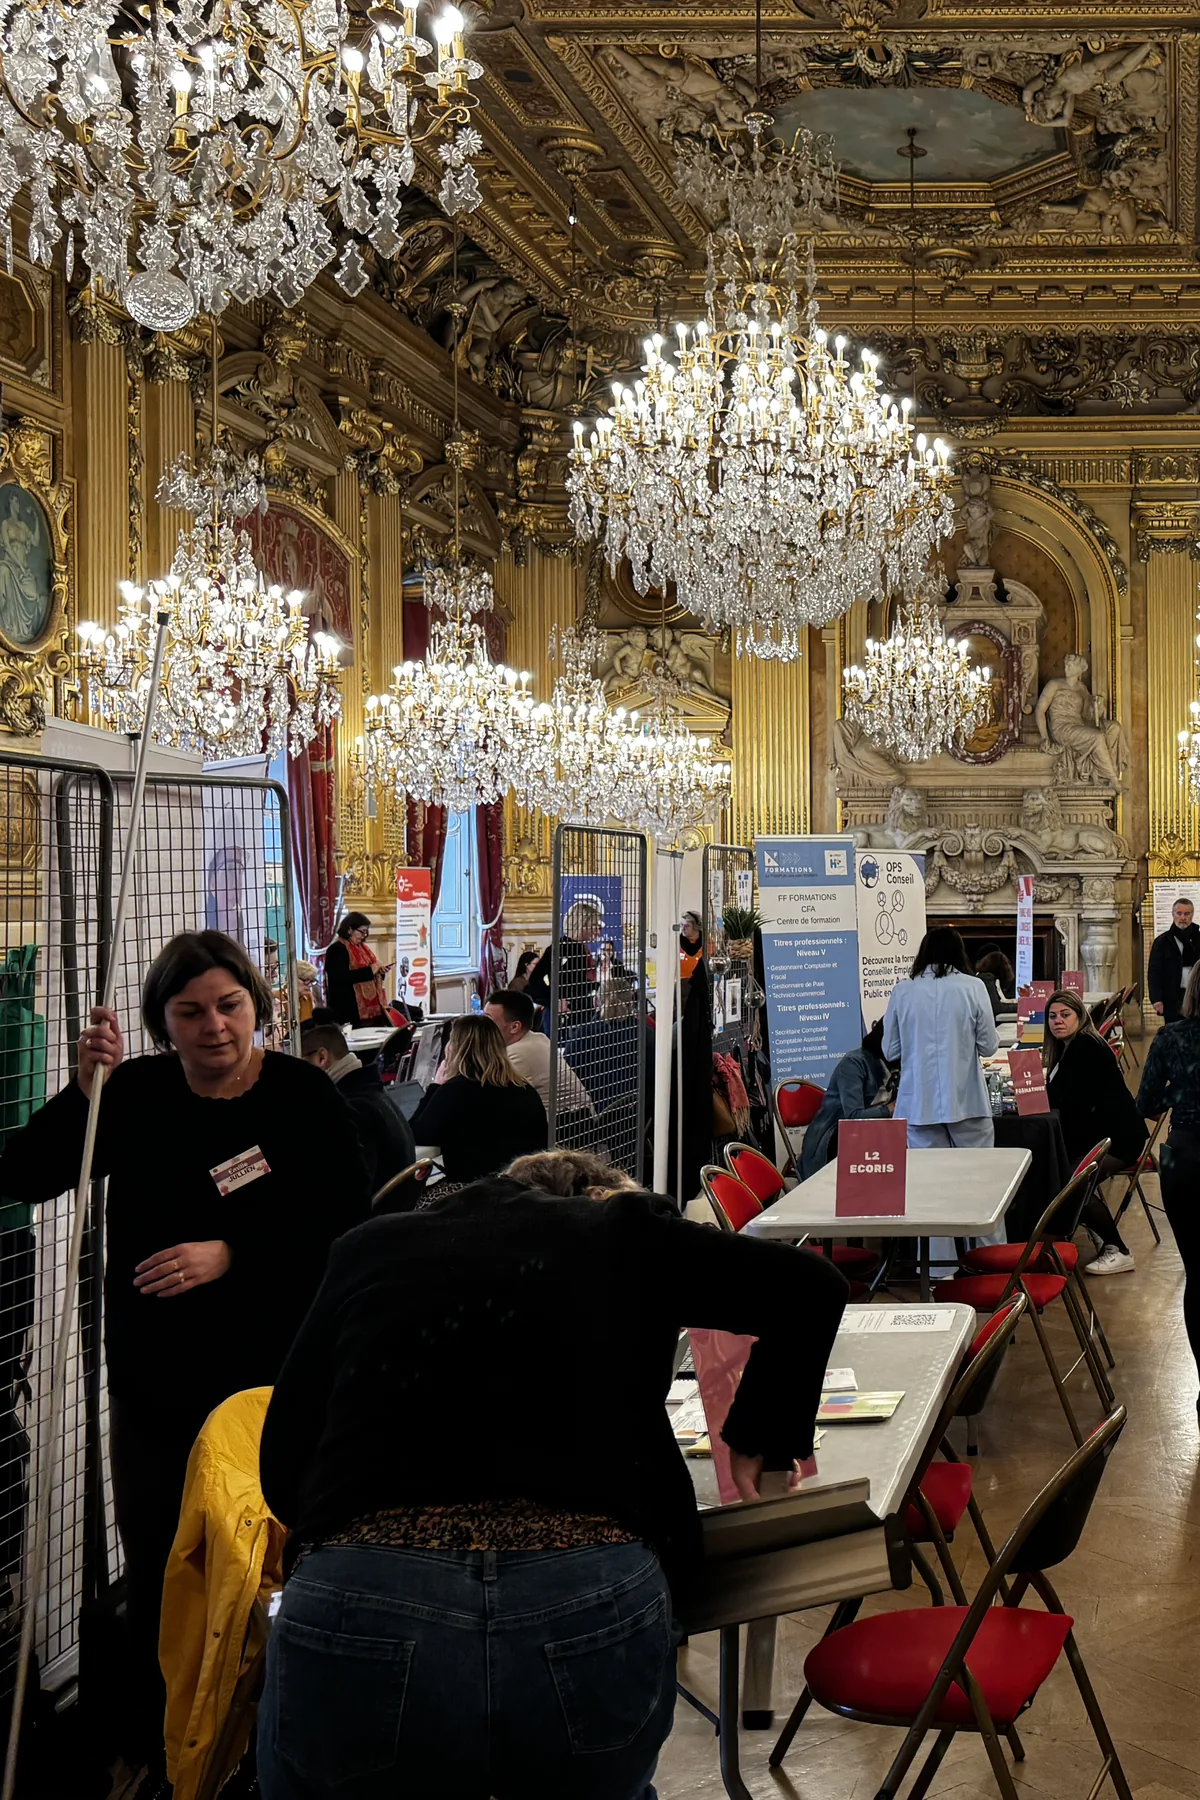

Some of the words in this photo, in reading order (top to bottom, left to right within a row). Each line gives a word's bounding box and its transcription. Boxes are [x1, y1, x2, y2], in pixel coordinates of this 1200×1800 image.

[886, 862, 902, 872] OPS
[886, 873, 914, 884] Conseil
[789, 893, 836, 901] FORMATIONS
[777, 917, 799, 925] Centre
[811, 916, 841, 924] formation
[794, 937, 843, 947] professionnels
[862, 956, 894, 965] Découvrez
[895, 955, 901, 963] la
[902, 955, 916, 963] form
[803, 962, 831, 970] Comptable
[863, 967, 893, 976] Conseiller
[863, 979, 894, 988] Formateur
[864, 989, 883, 999] Public
[797, 1001, 846, 1012] professionnels
[801, 1026, 828, 1034] Comptable
[864, 1152, 880, 1161] L2
[850, 1164, 894, 1174] ECORIS
